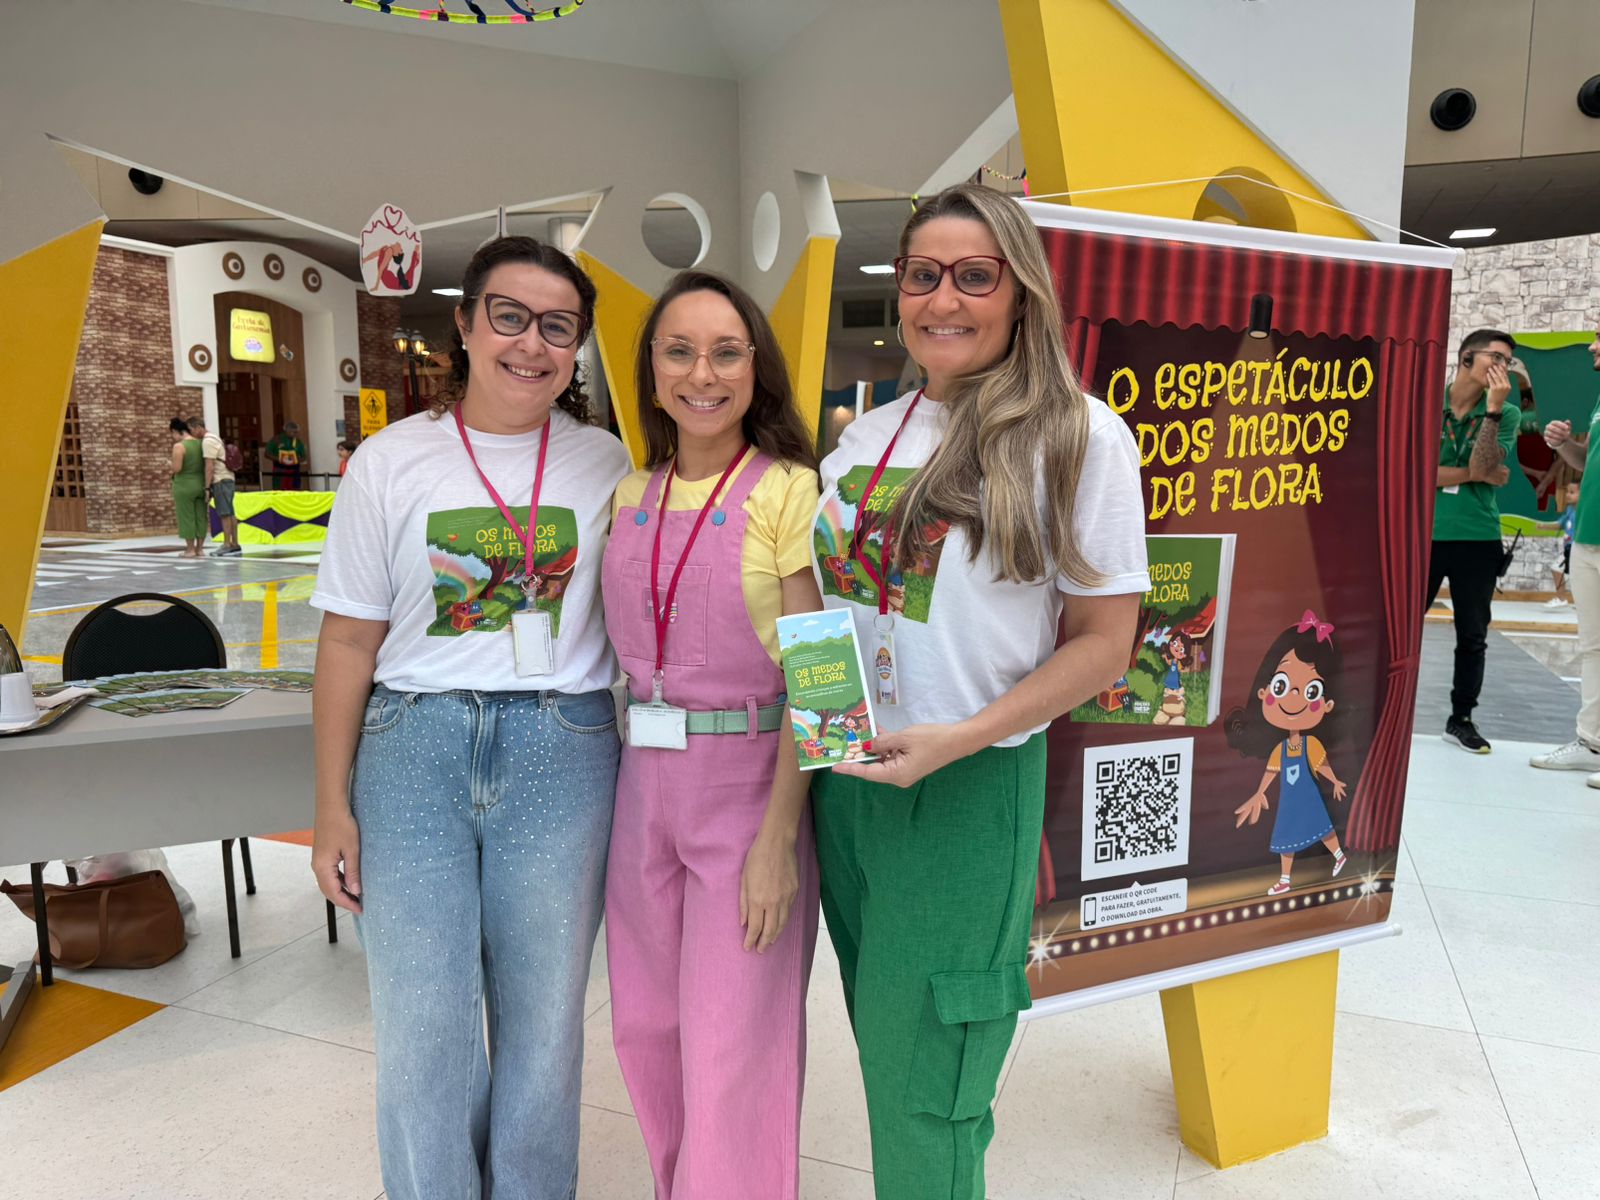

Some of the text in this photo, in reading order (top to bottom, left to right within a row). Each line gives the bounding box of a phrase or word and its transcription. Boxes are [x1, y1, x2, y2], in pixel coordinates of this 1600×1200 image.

[1107, 347, 1374, 414] O ESPETÁCULO
[1136, 408, 1350, 468] DOS MEDOS
[1149, 462, 1323, 520] DE FLORA
[475, 524, 556, 543] OS MOS
[484, 538, 558, 559] DE FLRA
[794, 667, 809, 679] OS
[811, 661, 846, 676] MEDOS
[798, 671, 847, 688] DE FLORA
[1101, 892, 1128, 902] ESCANEIE
[1143, 887, 1157, 895] CODE
[1101, 904, 1116, 912] PARA
[1106, 910, 1138, 920] DOWNLOAD
